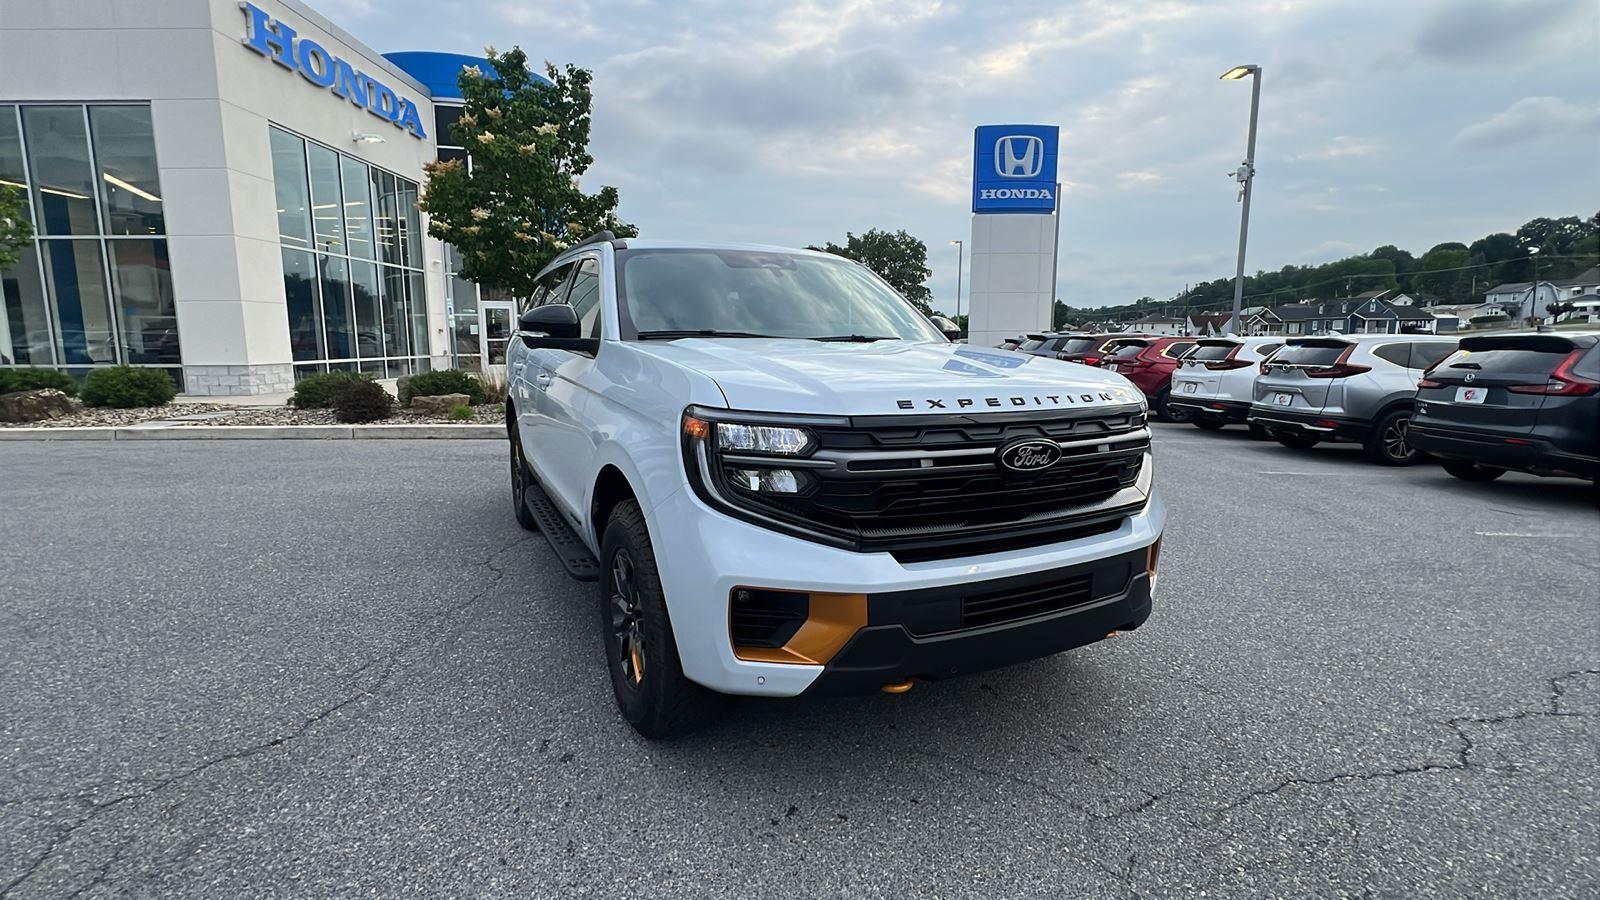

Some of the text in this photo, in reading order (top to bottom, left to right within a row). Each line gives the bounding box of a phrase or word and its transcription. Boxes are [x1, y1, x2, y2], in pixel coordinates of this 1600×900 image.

[240, 1, 427, 139] HONDA
[980, 189, 1053, 199] HONDA
[896, 393, 1113, 410] EXPEDITION
[1014, 446, 1052, 467] Ford
